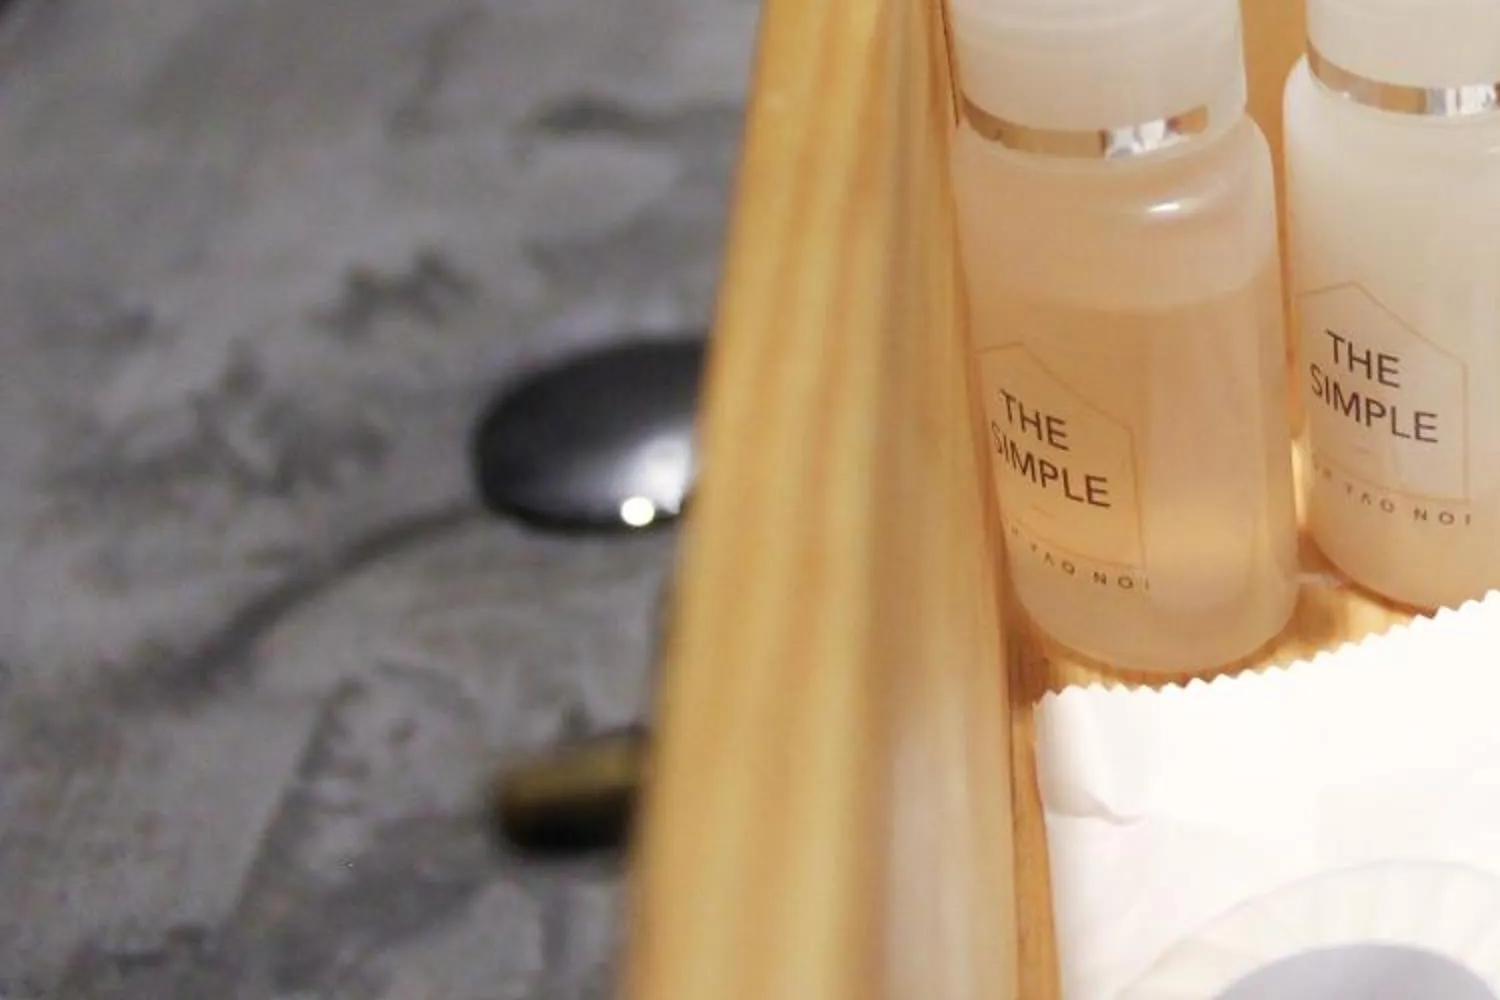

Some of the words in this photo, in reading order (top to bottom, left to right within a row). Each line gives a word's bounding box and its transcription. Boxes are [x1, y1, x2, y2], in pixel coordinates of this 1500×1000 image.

[1325, 328, 1400, 389] THE
[999, 387, 1070, 452] THE
[1308, 362, 1439, 443] SIMPLE
[990, 419, 1112, 510] SIMPLE
